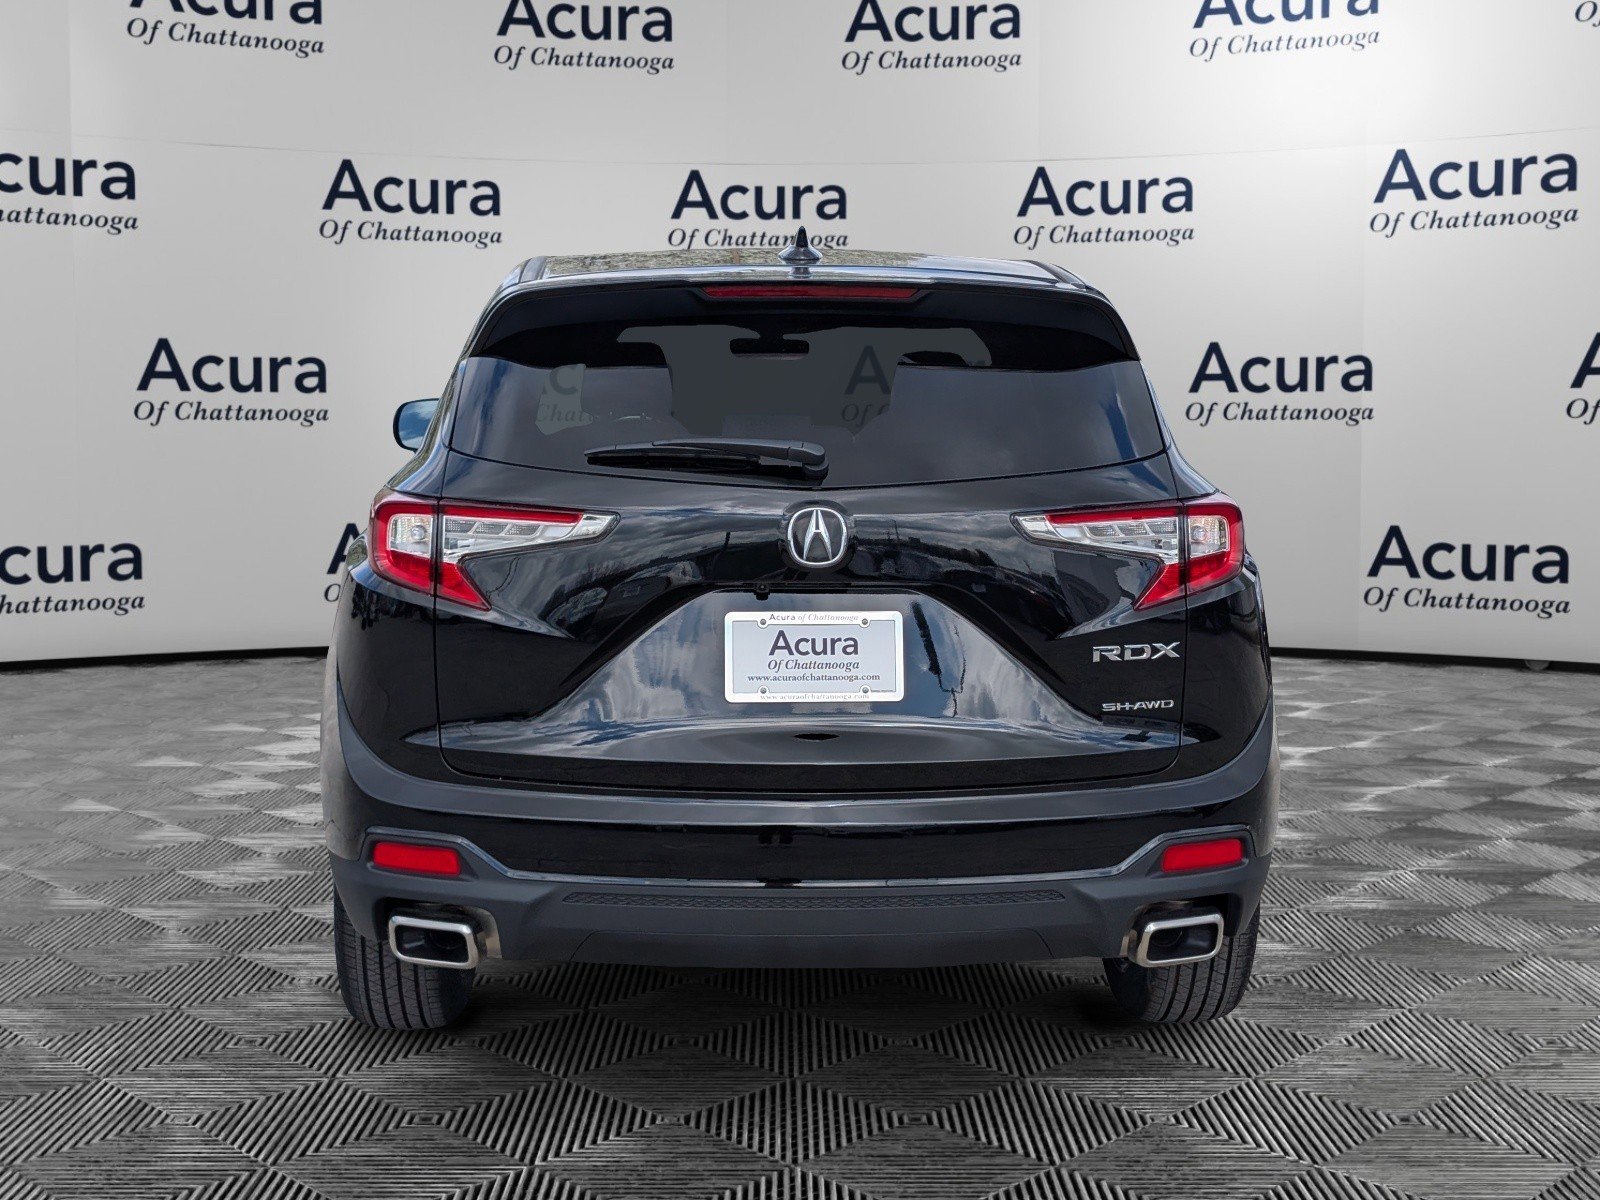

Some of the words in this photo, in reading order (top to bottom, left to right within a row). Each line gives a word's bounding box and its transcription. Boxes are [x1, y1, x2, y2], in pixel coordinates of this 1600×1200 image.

[129, 0, 323, 26] ura
[496, 0, 673, 43] Acura
[844, 0, 1021, 43] Acura
[1574, 0, 1600, 28] O
[126, 17, 164, 46] Of
[168, 21, 325, 59] Chattanooga
[1189, 36, 1223, 62] Of
[1227, 30, 1380, 55] Chattanooga
[493, 44, 527, 71] Of
[530, 46, 675, 76] Chattanooga
[841, 50, 874, 76] Of
[877, 50, 1022, 73] Chattanooga
[0, 152, 136, 201] cura
[321, 158, 501, 217] Acura
[1016, 165, 1194, 218] Acura
[1373, 148, 1578, 204] Acura
[670, 169, 848, 221] Acura
[0, 206, 139, 236] attanooga
[318, 219, 353, 245] Of
[357, 220, 502, 250] Chattanooga
[1369, 211, 1406, 239] Of
[1409, 208, 1579, 232] Chattanooga
[667, 227, 700, 250] Of
[704, 227, 848, 250] Chattanoga
[1013, 225, 1046, 251] Of
[1048, 224, 1195, 247] Chattanooga
[136, 337, 328, 395] Acura
[1187, 341, 1374, 394] Acura
[133, 400, 170, 427] Of
[174, 400, 330, 428] Chattanooga
[1184, 401, 1219, 428] Of
[1222, 401, 1375, 427] Chattanooga
[0, 542, 143, 586] cura
[1366, 524, 1570, 585] Acura
[0, 594, 146, 616] hattanooga
[769, 613, 796, 621] Acura
[797, 614, 806, 623] of
[808, 613, 859, 623] Chattanooga
[1363, 586, 1399, 613] Of
[1403, 587, 1571, 620] Chattanooga
[768, 629, 859, 656] Acura
[1092, 641, 1181, 663] RDX
[747, 673, 881, 682] www.acuraofchattanooga.com
[767, 659, 784, 674] Of
[785, 659, 860, 672] Chattanooga
